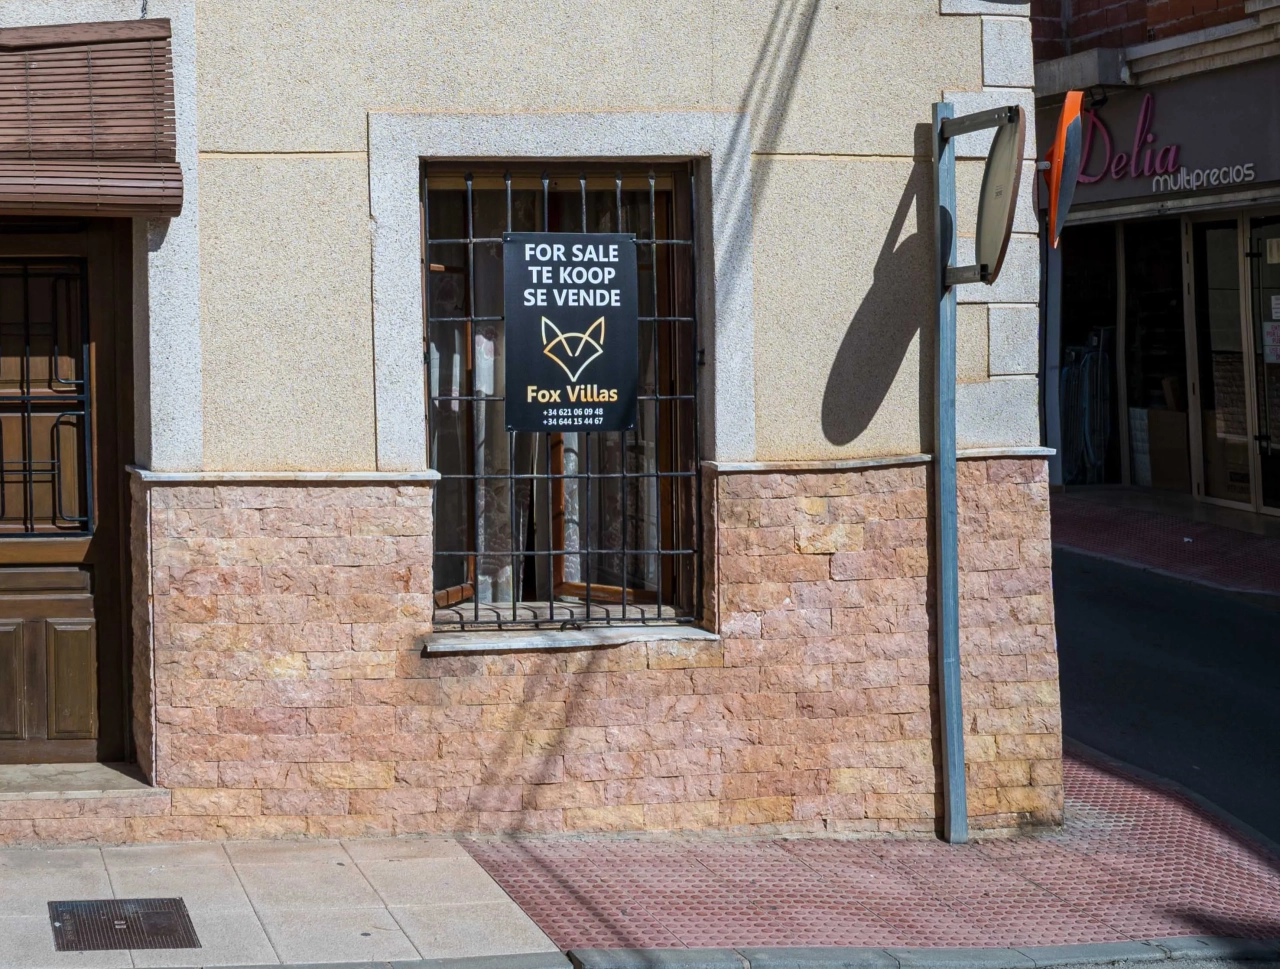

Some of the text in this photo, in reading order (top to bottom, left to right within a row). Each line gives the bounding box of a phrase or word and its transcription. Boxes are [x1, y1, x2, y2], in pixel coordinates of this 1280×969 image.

[1077, 93, 1179, 183] Delia
[1152, 163, 1255, 192] multiprecios
[524, 243, 619, 262] FOR SALE
[527, 266, 616, 285] TE KOOP
[523, 288, 621, 307] SE VENDE
[527, 384, 618, 402] Fox Villas
[542, 407, 604, 416] +34 621 06 09 48
[542, 417, 604, 425] +34 644 15 44 67
